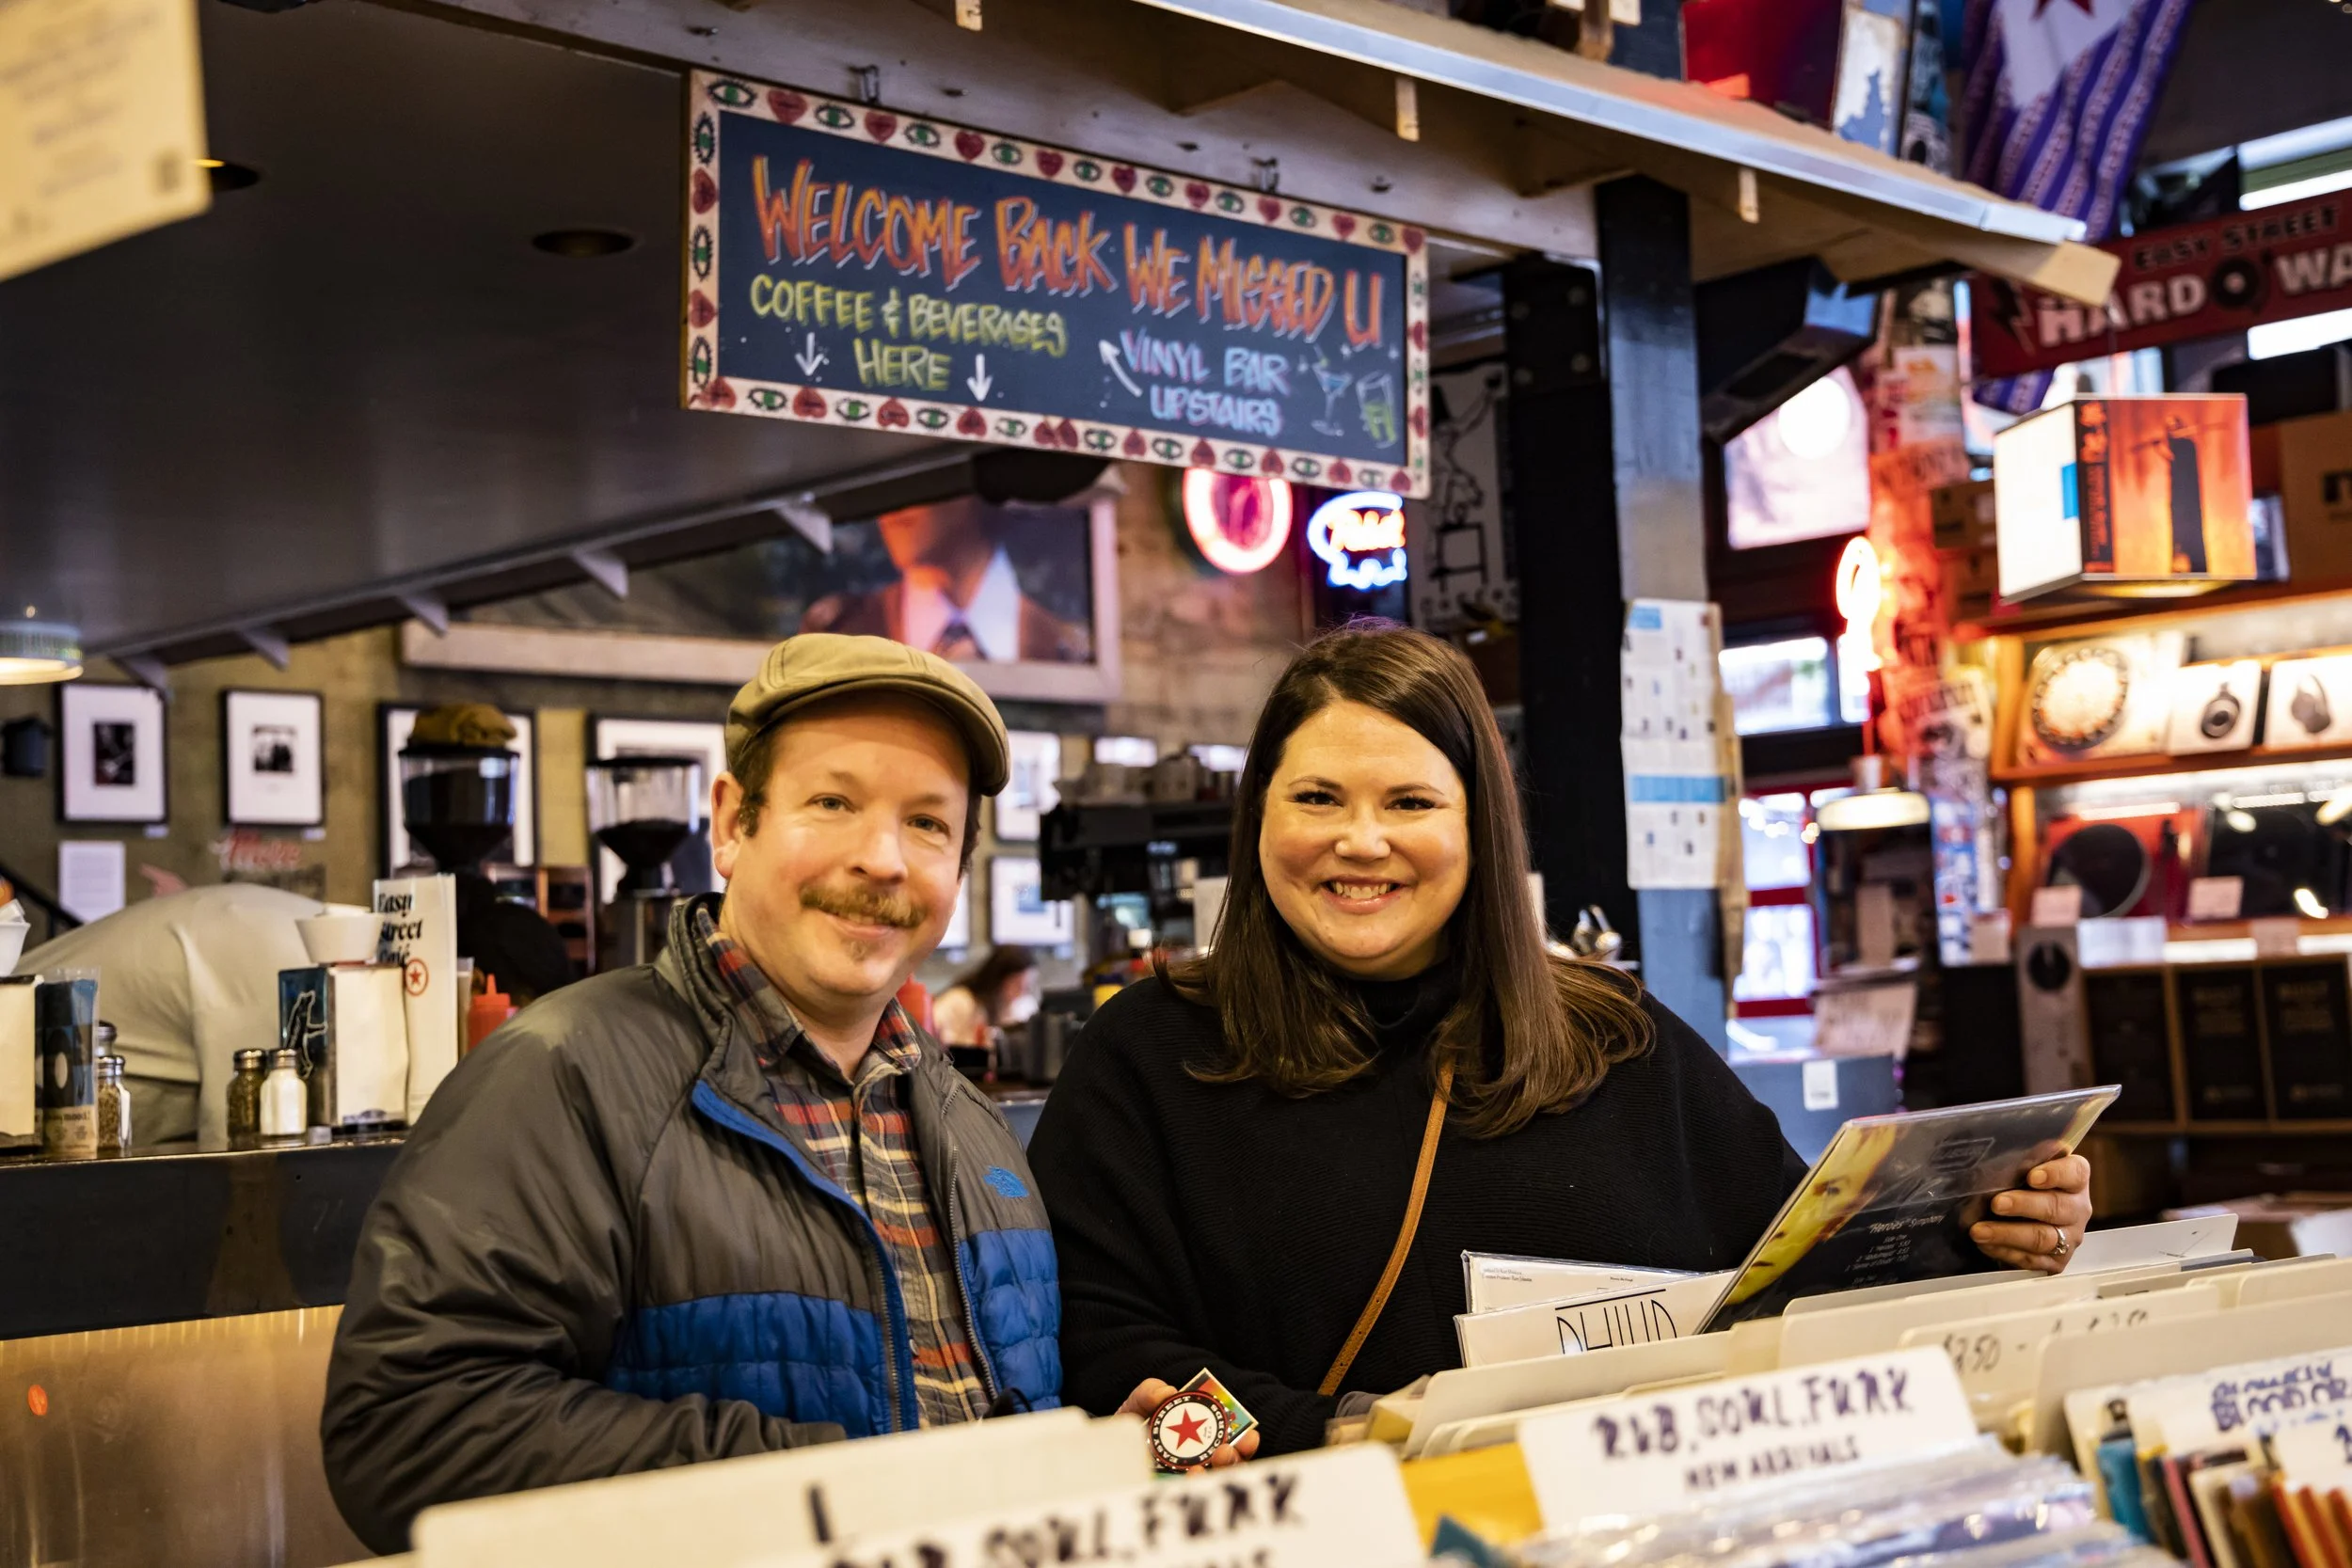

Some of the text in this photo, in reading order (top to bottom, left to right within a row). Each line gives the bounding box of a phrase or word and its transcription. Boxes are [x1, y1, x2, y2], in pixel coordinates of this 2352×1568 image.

[753, 154, 1383, 352] WELCOME BACK WE MISSED U
[751, 274, 1068, 358] COFFEE & BEVERAGES
[2038, 274, 2207, 347] HARD
[853, 336, 952, 392] HERE
[1120, 326, 1291, 397] VINYL BAR
[1150, 383, 1282, 438] UPSTAIRS
[380, 918, 422, 942] treet
[1152, 1394, 1192, 1464] EASY STREET
